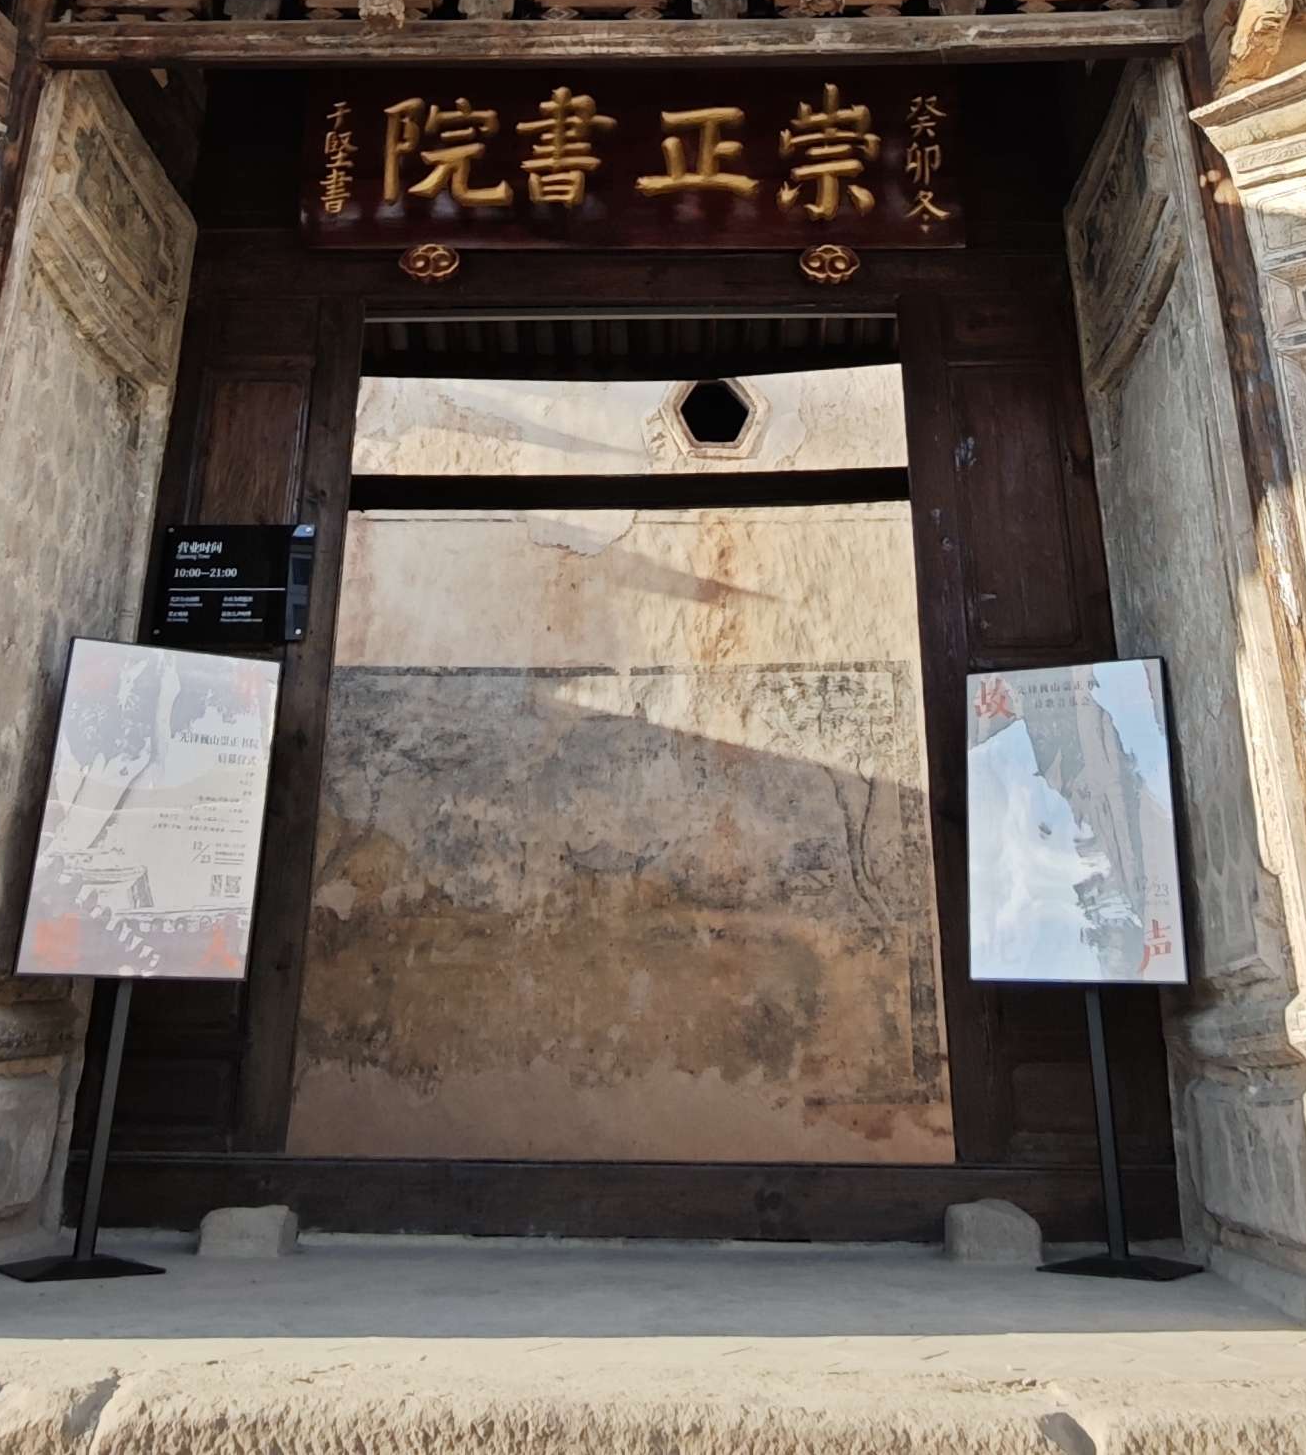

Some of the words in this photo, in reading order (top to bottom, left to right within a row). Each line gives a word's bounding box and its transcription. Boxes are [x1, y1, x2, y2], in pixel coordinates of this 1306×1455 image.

[383, 83, 881, 222] 崇正書院
[903, 95, 950, 233] 癸卯冬
